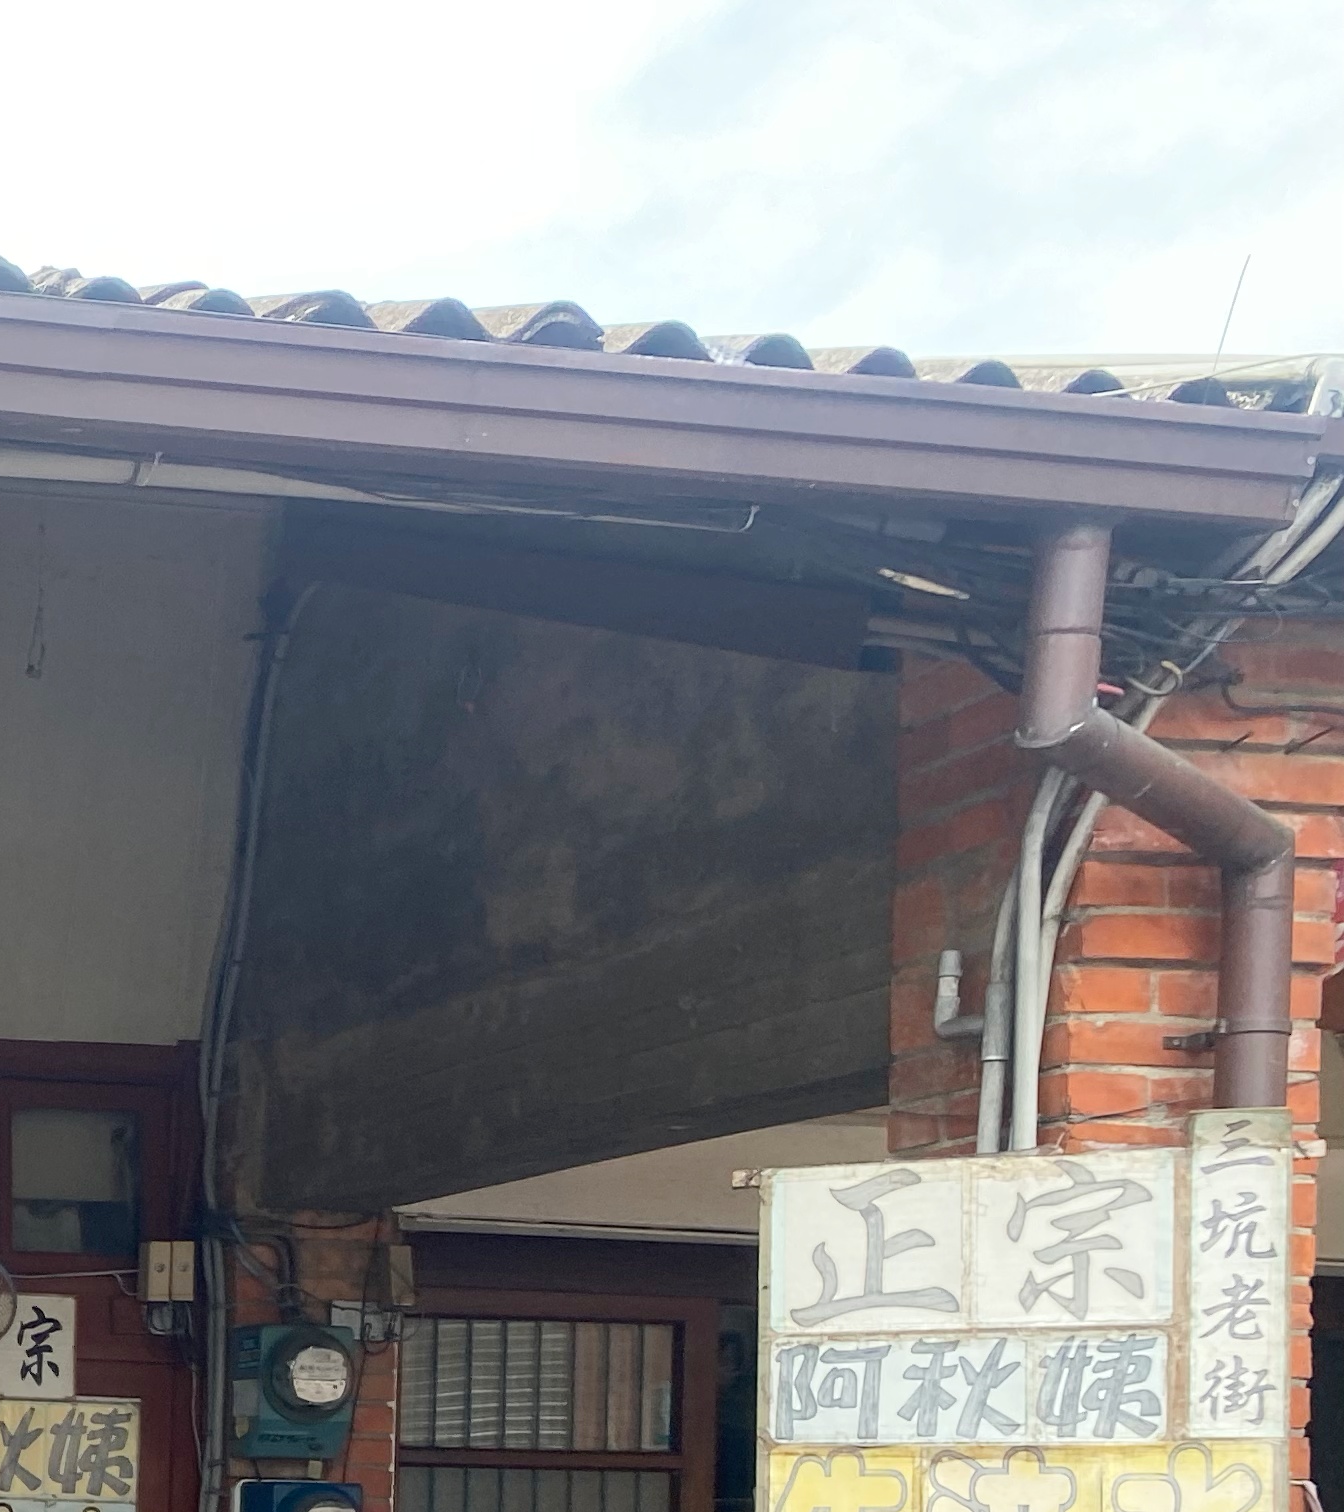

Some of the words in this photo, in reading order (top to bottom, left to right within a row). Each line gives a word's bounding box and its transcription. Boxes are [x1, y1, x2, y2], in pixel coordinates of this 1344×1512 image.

[790, 1160, 1154, 1328] 正宗
[1200, 1120, 1279, 1427] 三坑老街
[776, 1335, 1163, 1441] 阿秋姨
